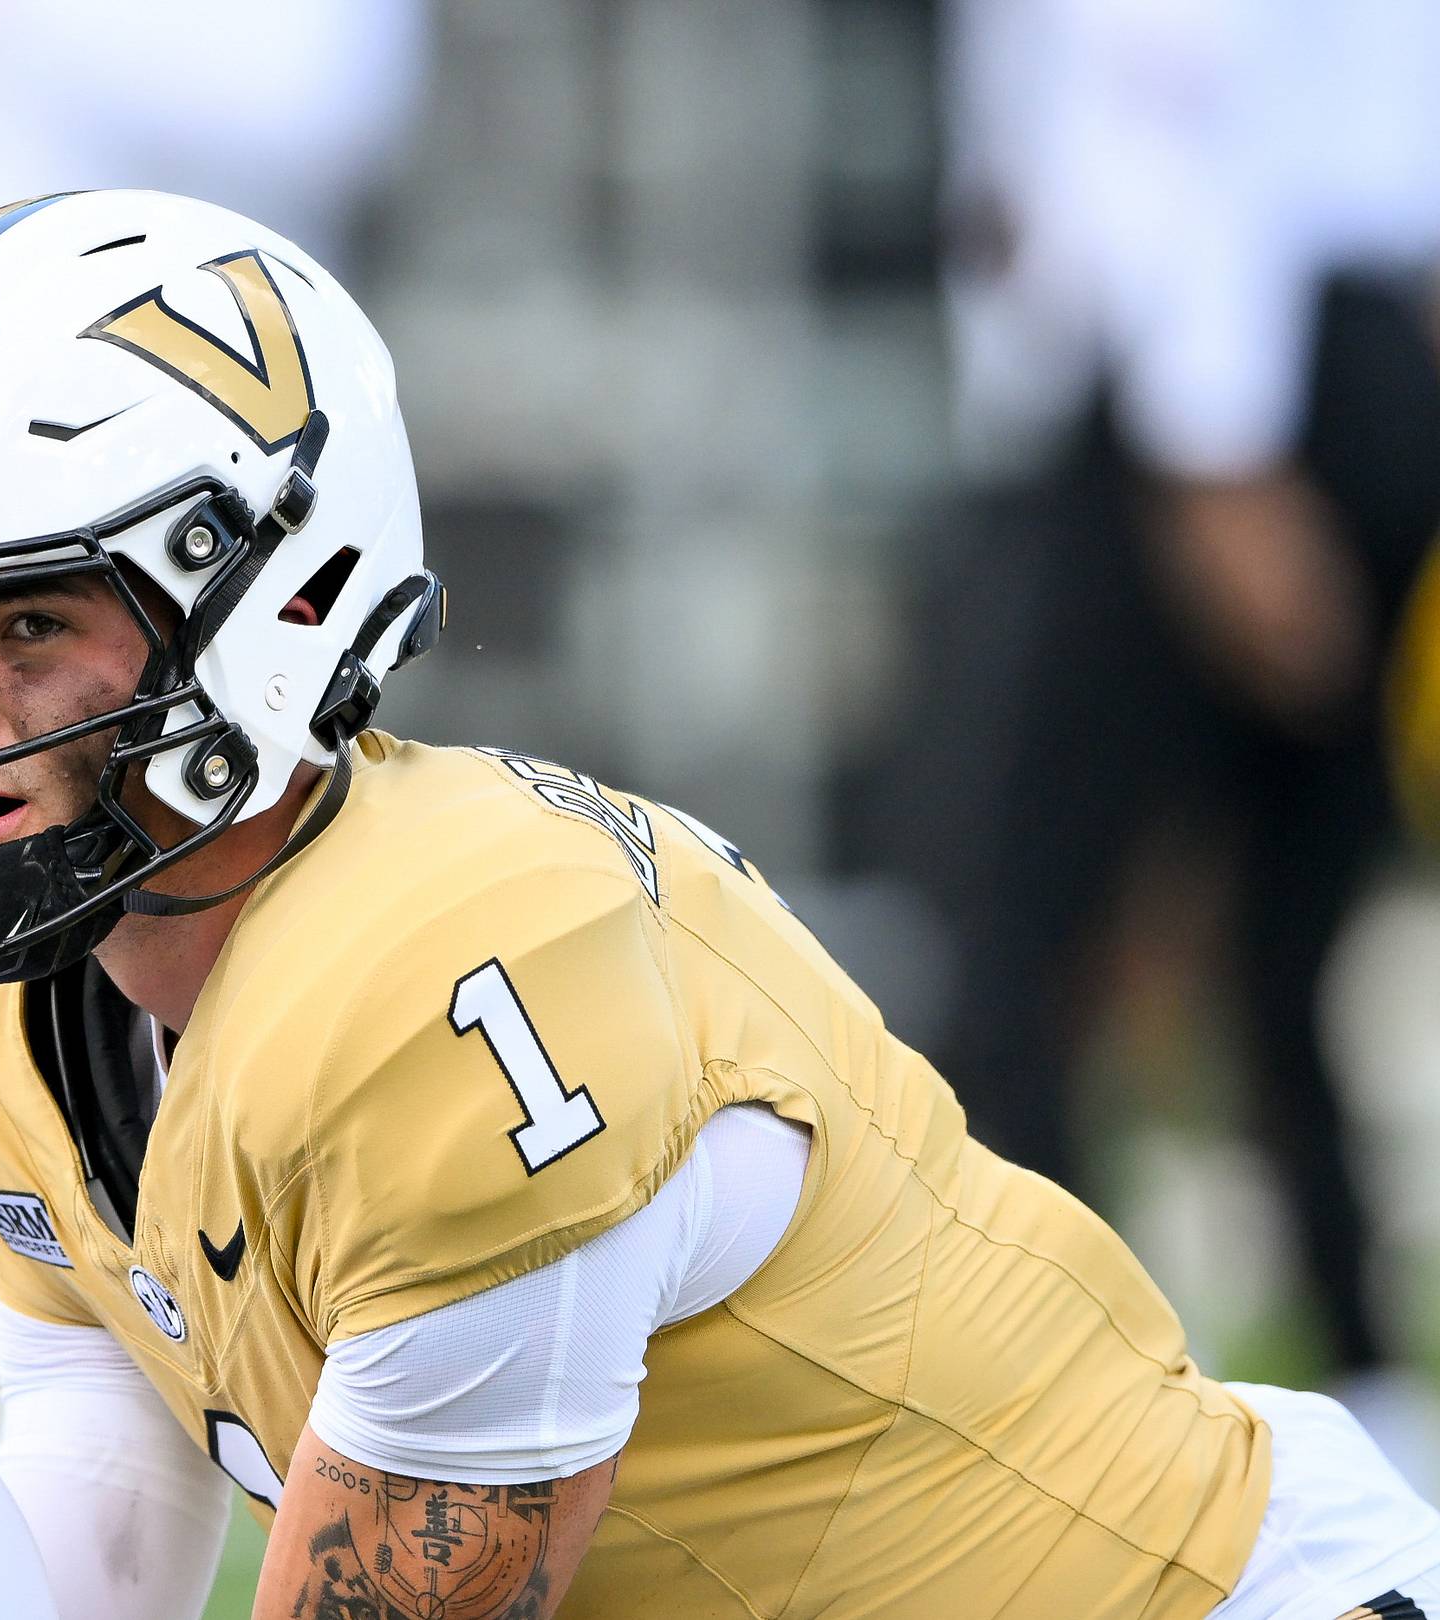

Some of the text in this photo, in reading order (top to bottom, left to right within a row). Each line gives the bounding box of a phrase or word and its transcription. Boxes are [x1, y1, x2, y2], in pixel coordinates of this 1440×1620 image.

[76, 248, 317, 457] V
[447, 957, 607, 1177] 1
[315, 1456, 370, 1495] 2005
